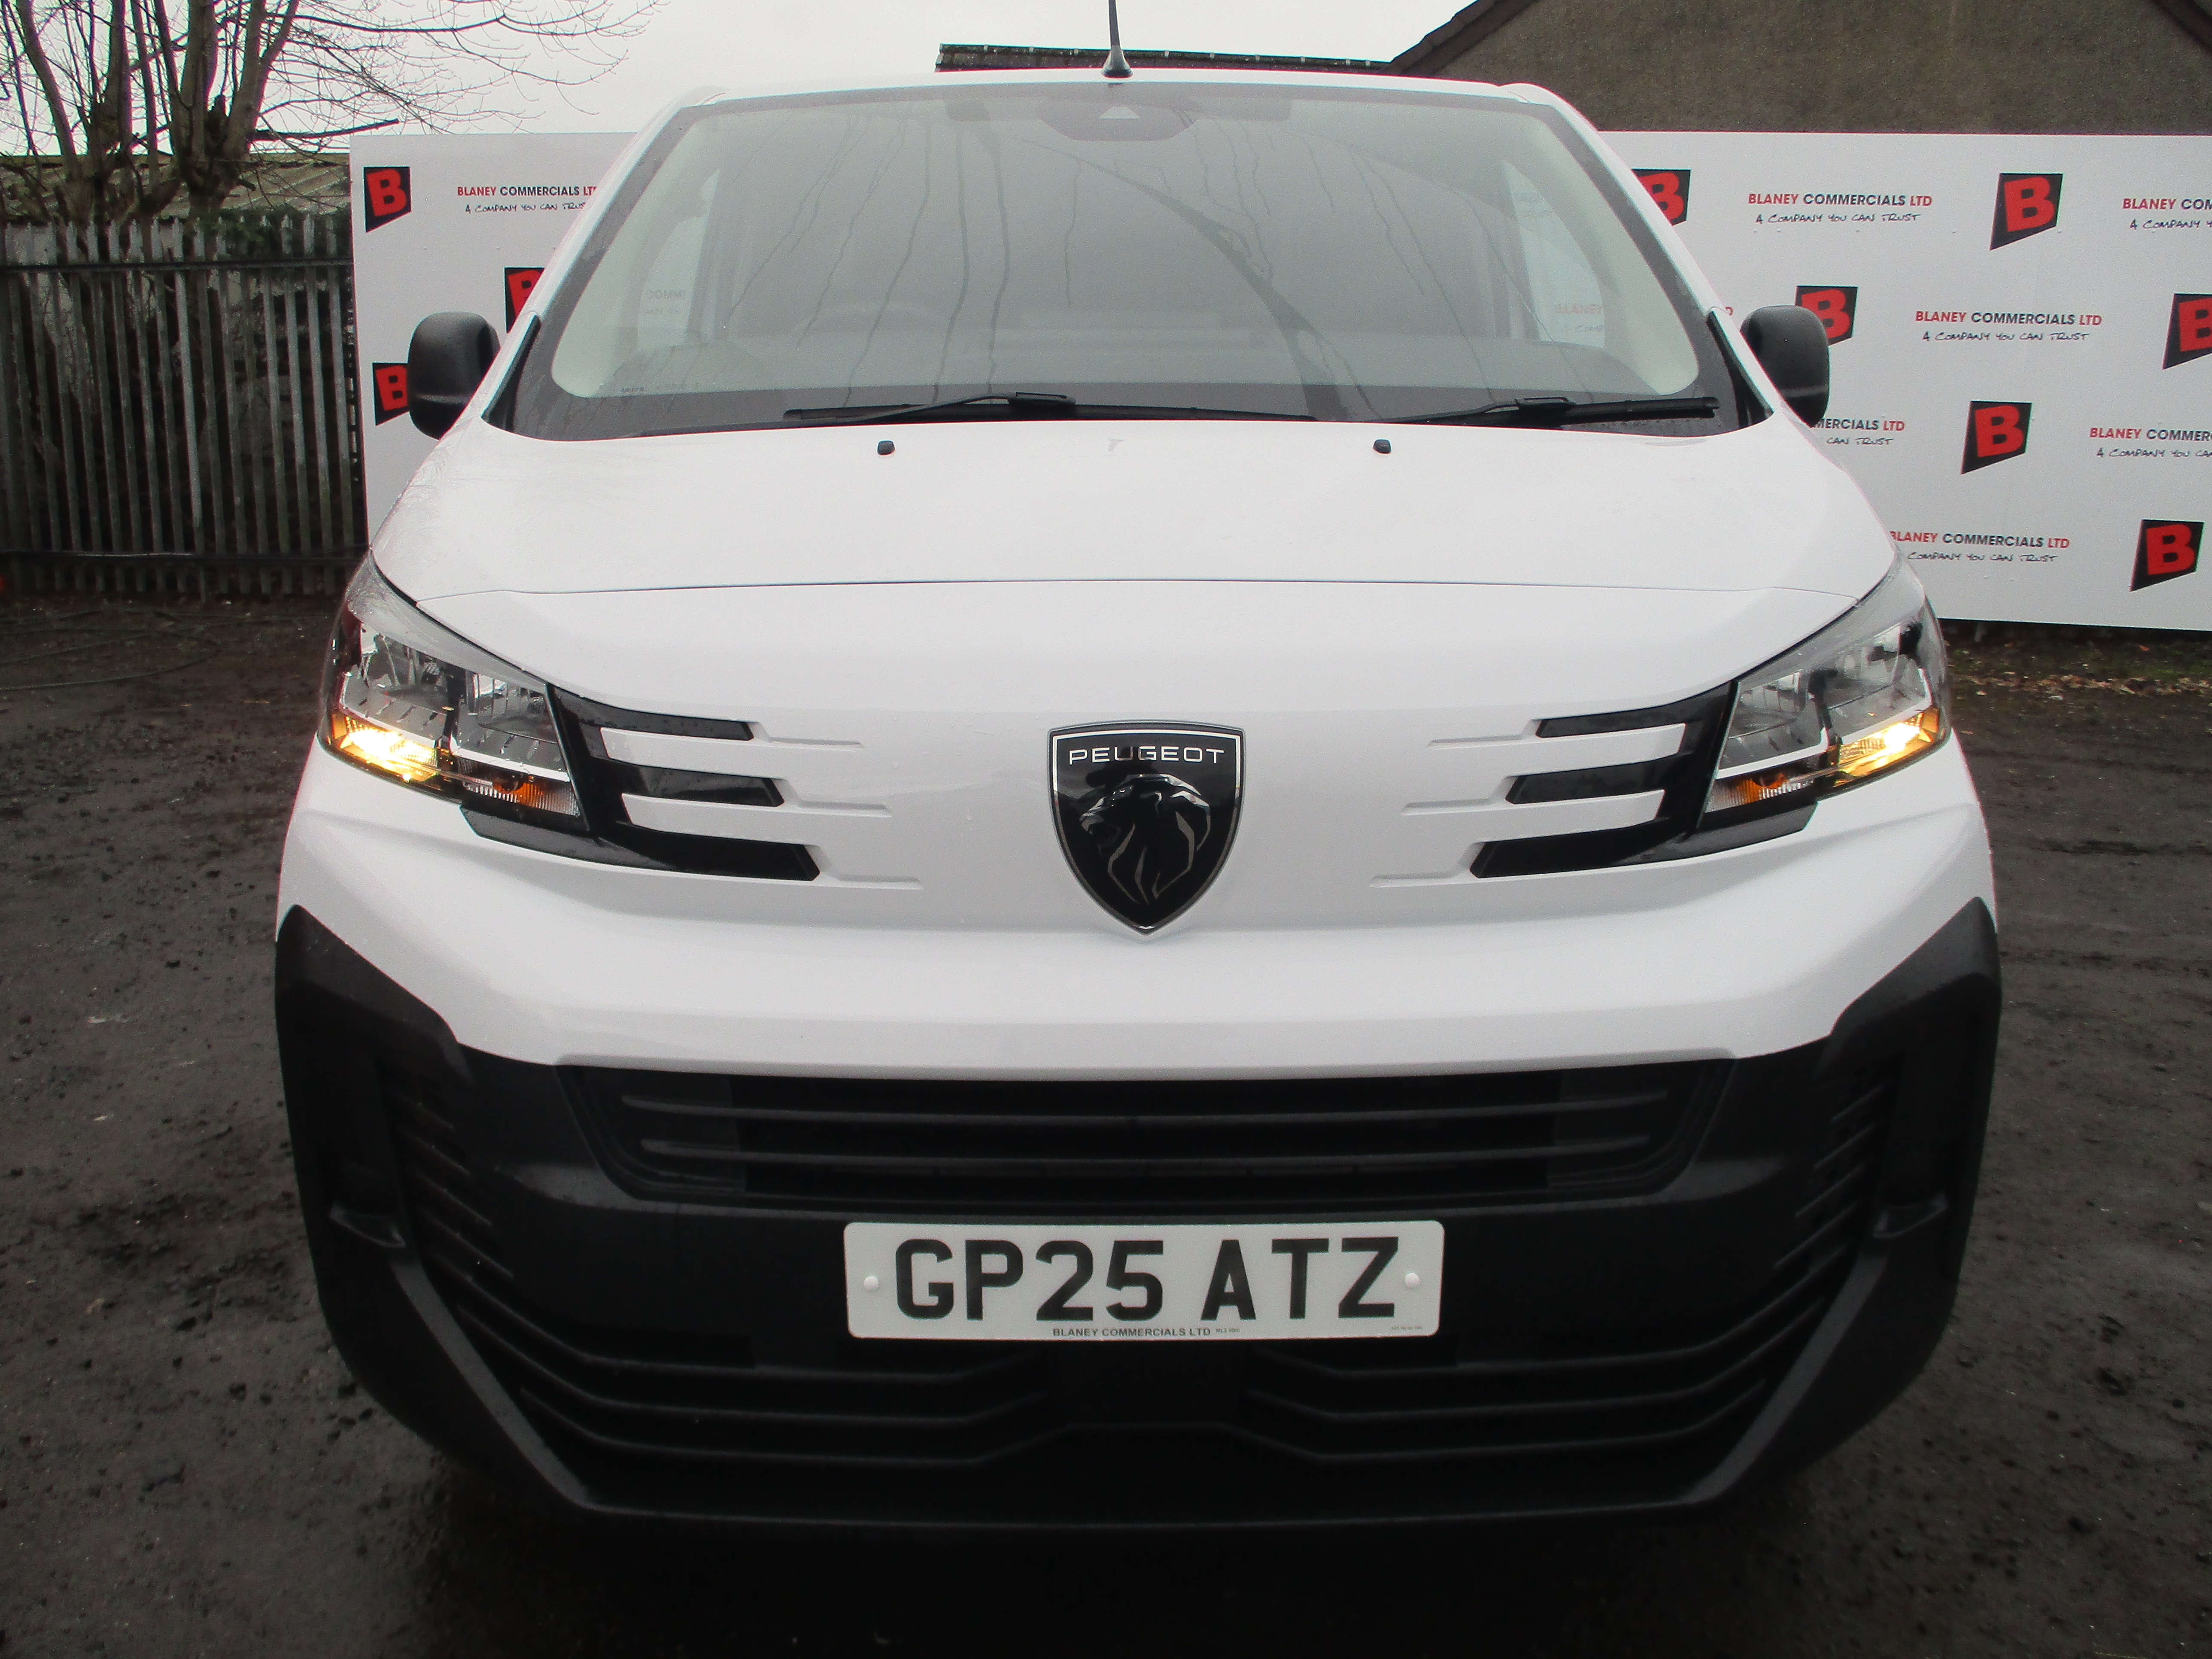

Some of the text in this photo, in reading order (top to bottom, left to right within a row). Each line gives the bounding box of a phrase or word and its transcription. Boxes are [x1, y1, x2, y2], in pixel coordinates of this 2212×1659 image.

[367, 168, 407, 217] B
[457, 186, 596, 196] BLANEY COMMERCIALS LT
[1748, 193, 1932, 207] BLANEY COMMERCIALS LTD
[2004, 176, 2055, 232] B
[2122, 198, 2177, 210] BLANEY
[465, 204, 471, 214] A
[474, 204, 517, 213] COMPANY
[540, 203, 558, 211] CAN
[1755, 215, 1764, 224] A
[1768, 213, 1823, 222] COMPANY
[1851, 214, 1875, 222] CAN
[1882, 213, 1922, 222] TRUST
[2130, 219, 2138, 230] A
[2143, 219, 2201, 228] COMPANY
[1915, 311, 2102, 325] BLANEY COMMERCIALS LTD
[1922, 331, 2091, 341] A COMPANY YOU CAN TRUST
[1883, 420, 1905, 431] LTD
[1975, 404, 2024, 457] B
[2090, 427, 2142, 438] BLANEY
[1827, 437, 1894, 445] CAN TRUST
[2096, 447, 2105, 457] A
[2109, 449, 2166, 457] COMPANY
[1942, 533, 2044, 547] COMMERCIALS
[2048, 538, 2070, 549] LTD
[2146, 523, 2195, 575] B
[1907, 551, 1962, 561] COMPANY
[2019, 554, 2057, 562] TRUST
[1069, 746, 1225, 765] PEUGEOT
[895, 1237, 1398, 1322] GP25 ATZ
[1053, 1328, 1097, 1336] BLANEY
[1102, 1328, 1186, 1336] COMMERCIALS
[1189, 1328, 1211, 1336] LTD
